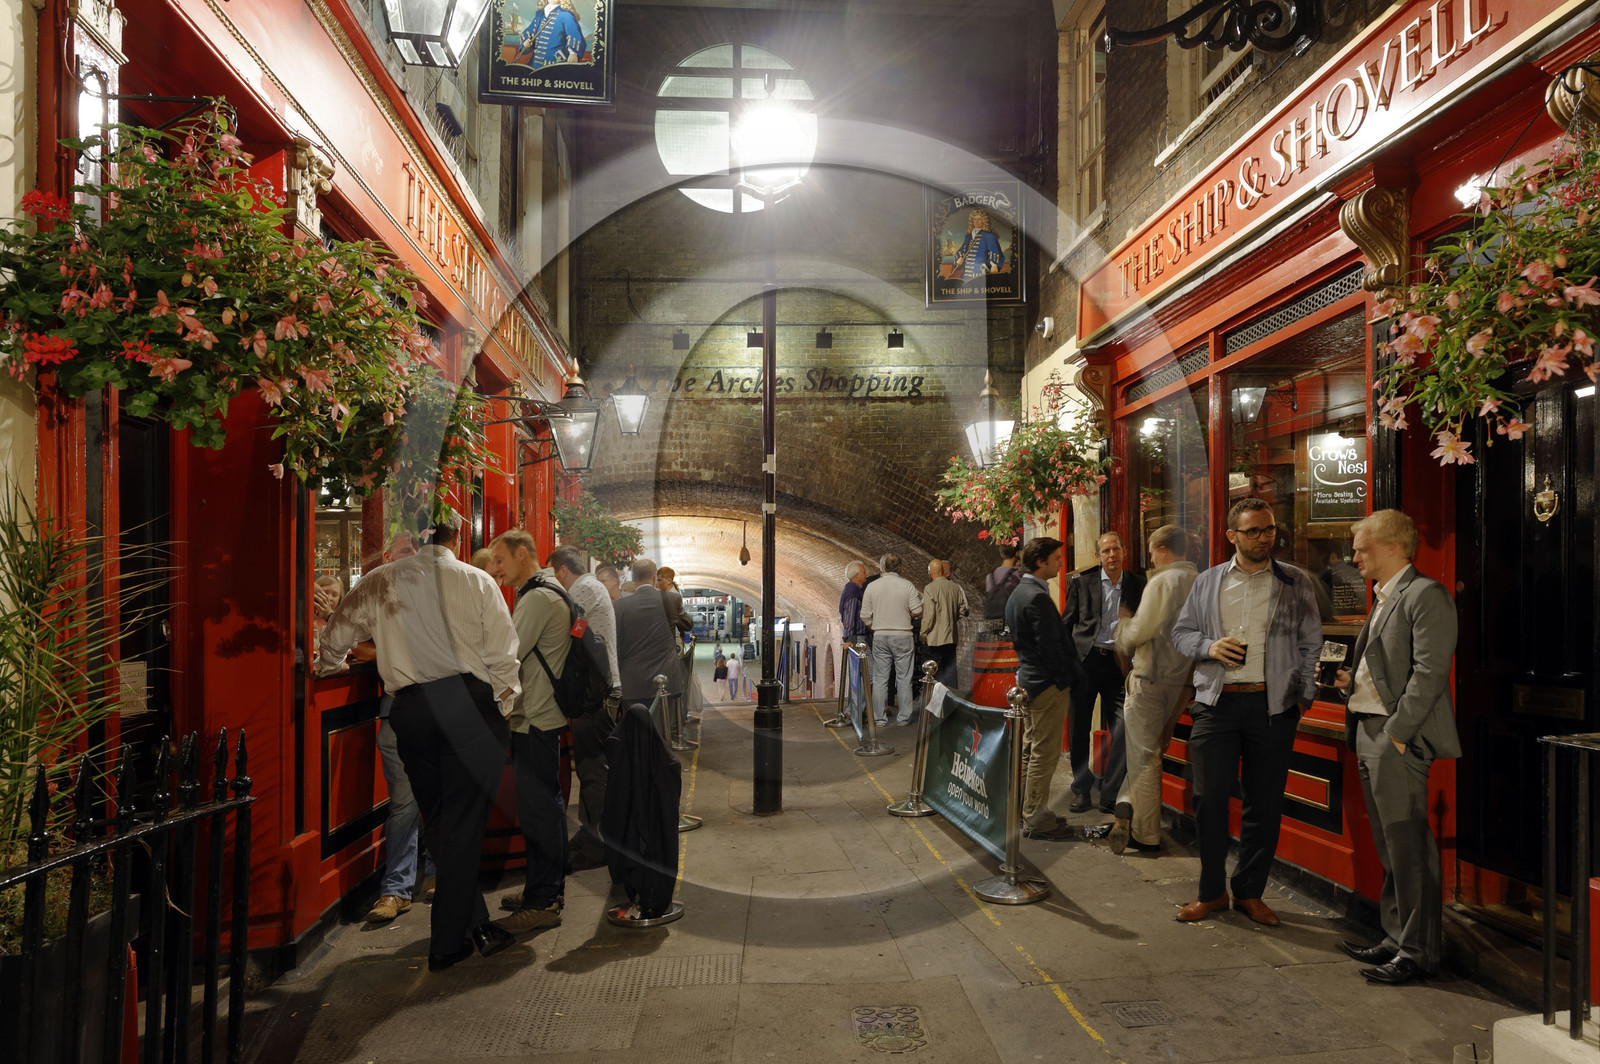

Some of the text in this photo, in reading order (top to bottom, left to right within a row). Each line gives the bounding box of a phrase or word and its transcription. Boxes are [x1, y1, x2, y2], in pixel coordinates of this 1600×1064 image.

[500, 76, 594, 90] THE SHIP & SHOVELL
[1116, 0, 1493, 299] THE SHIP & SHOVELL
[953, 195, 996, 208] BADGER
[407, 161, 546, 387] THE SHIP & SHOVELL
[980, 286, 1012, 294] SHOVELL
[706, 369, 796, 394] Arches
[803, 367, 925, 398] Shopping
[1308, 446, 1358, 461] Crows
[951, 751, 988, 799] Heineken
[947, 781, 989, 820] open your world
